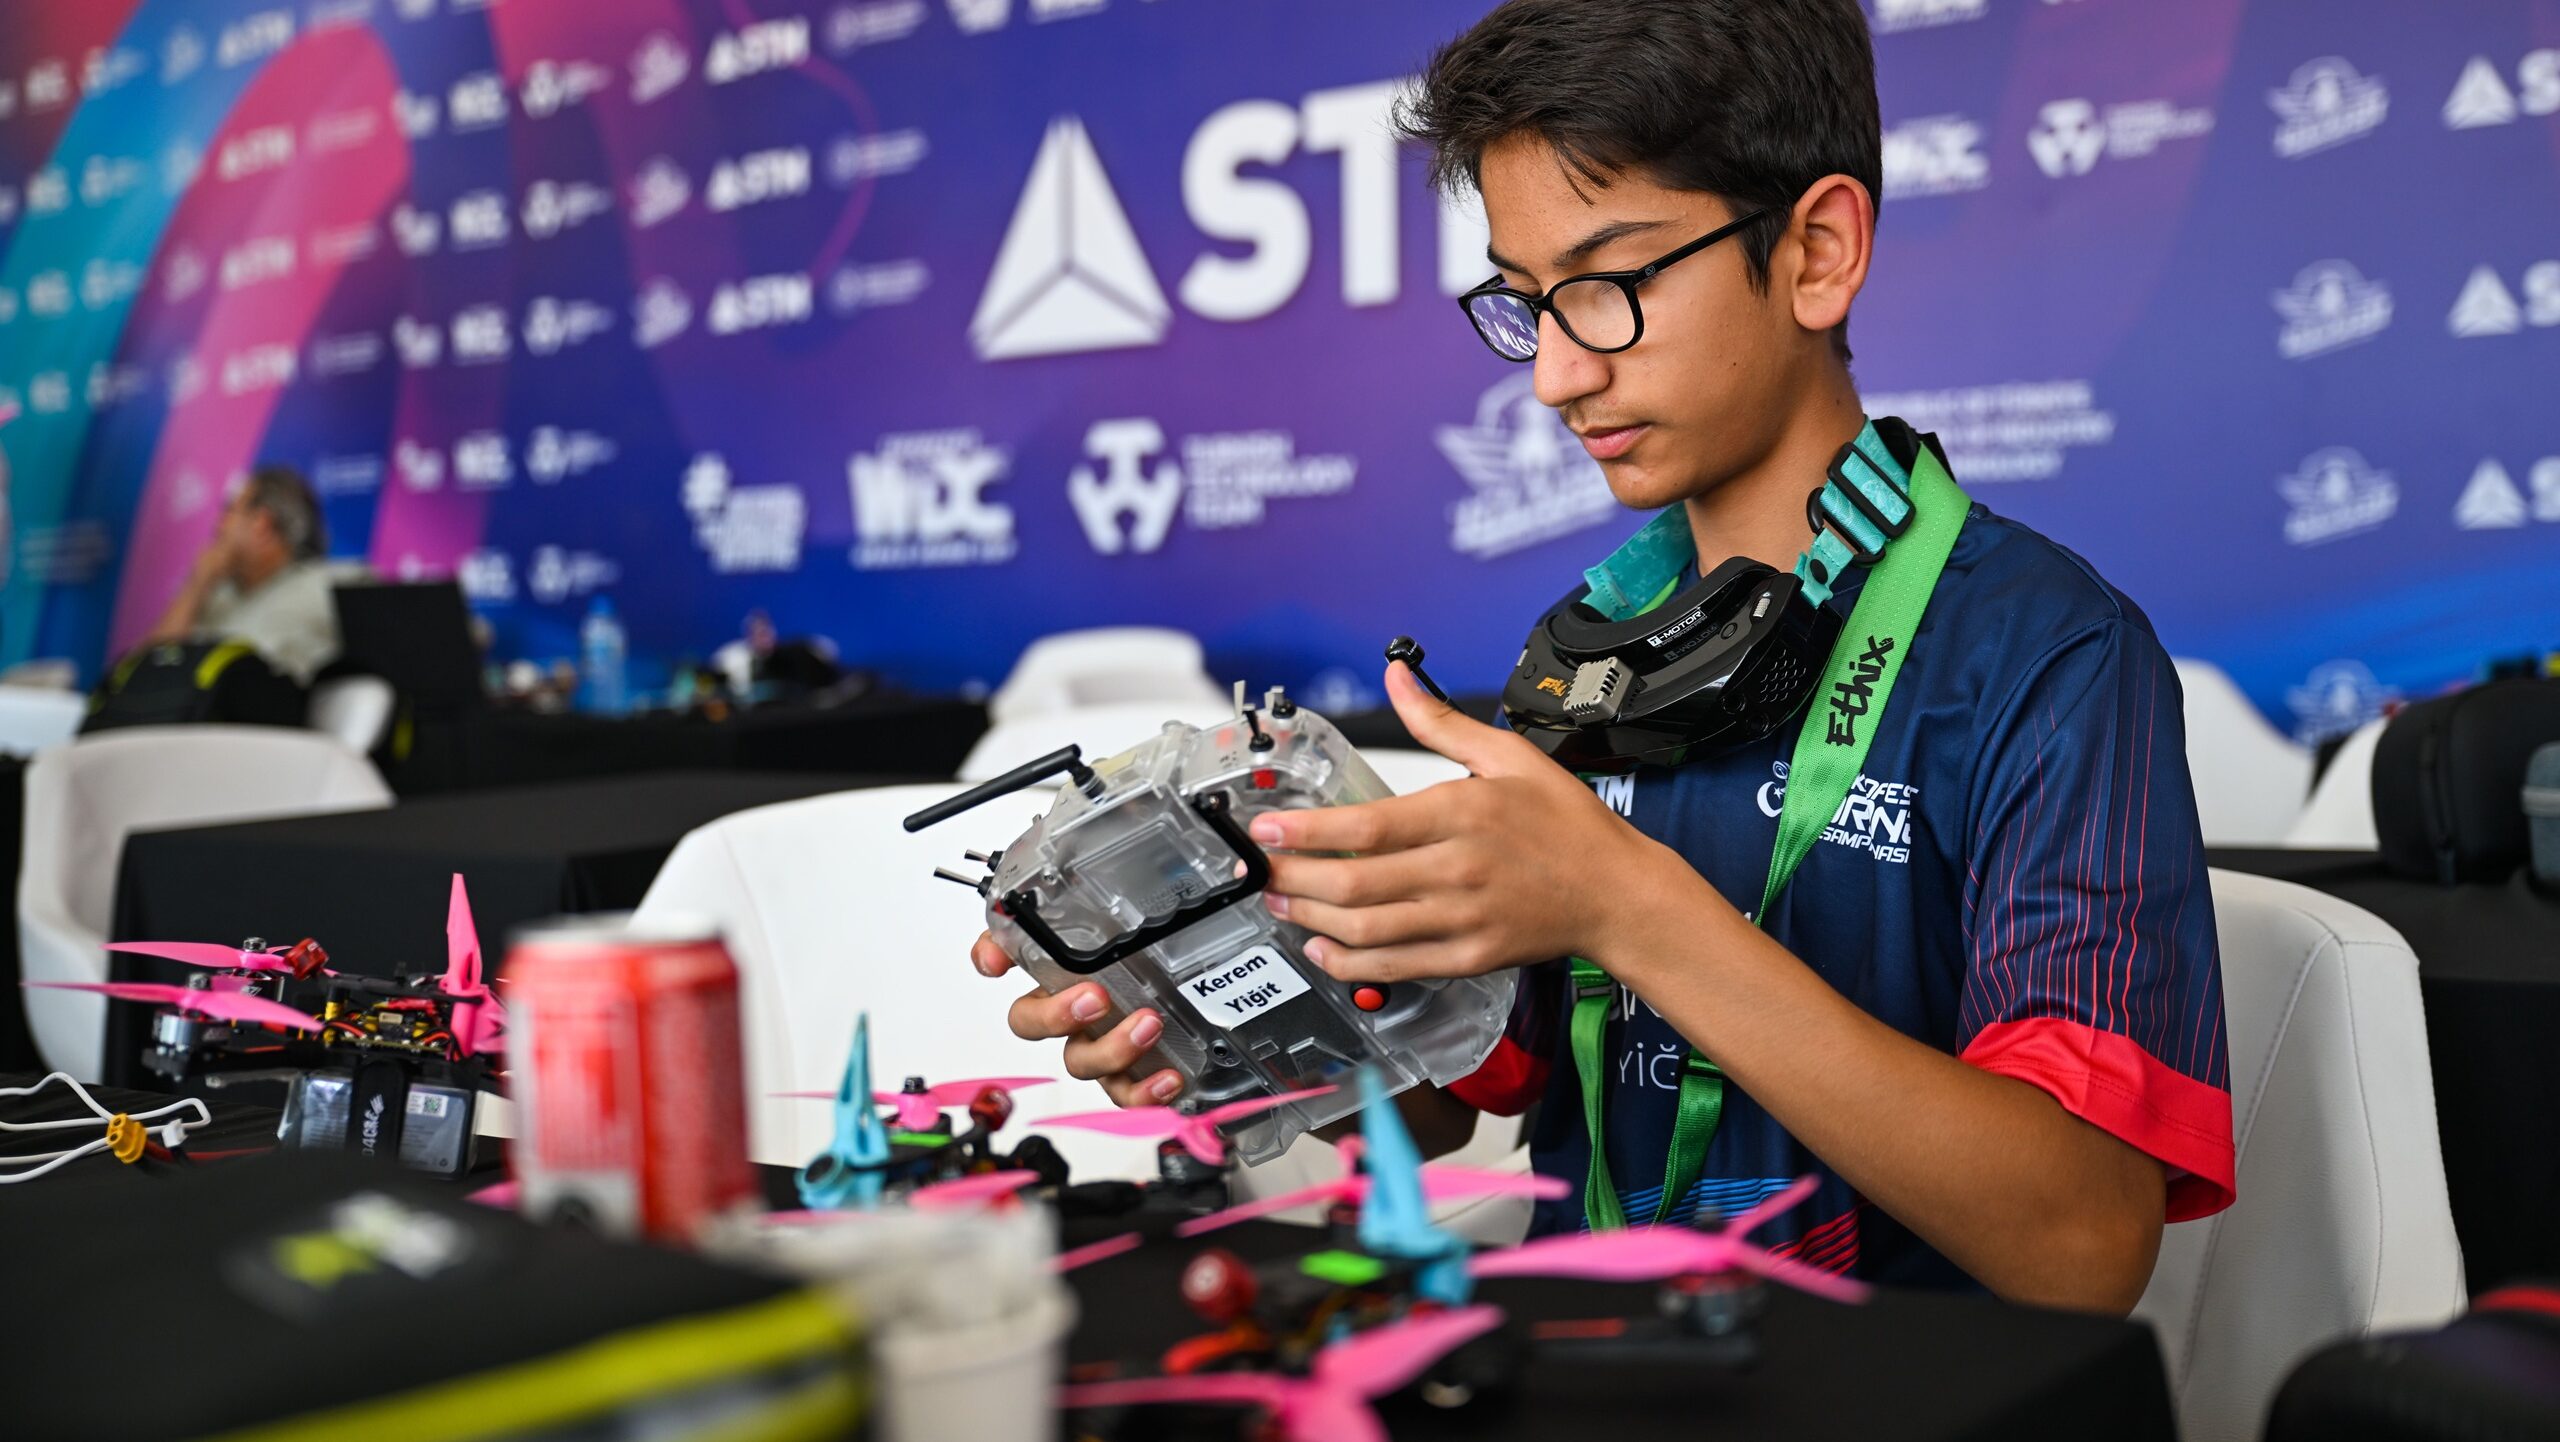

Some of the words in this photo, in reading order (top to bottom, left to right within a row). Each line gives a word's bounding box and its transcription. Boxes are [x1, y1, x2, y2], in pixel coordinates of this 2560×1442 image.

[1647, 610, 1701, 647] T-MOTOR
[1589, 772, 1636, 817] TM
[1192, 955, 1268, 997] Kerem
[1224, 981, 1282, 1014] Yiğit
[1619, 1042, 1680, 1090] YİĞ
